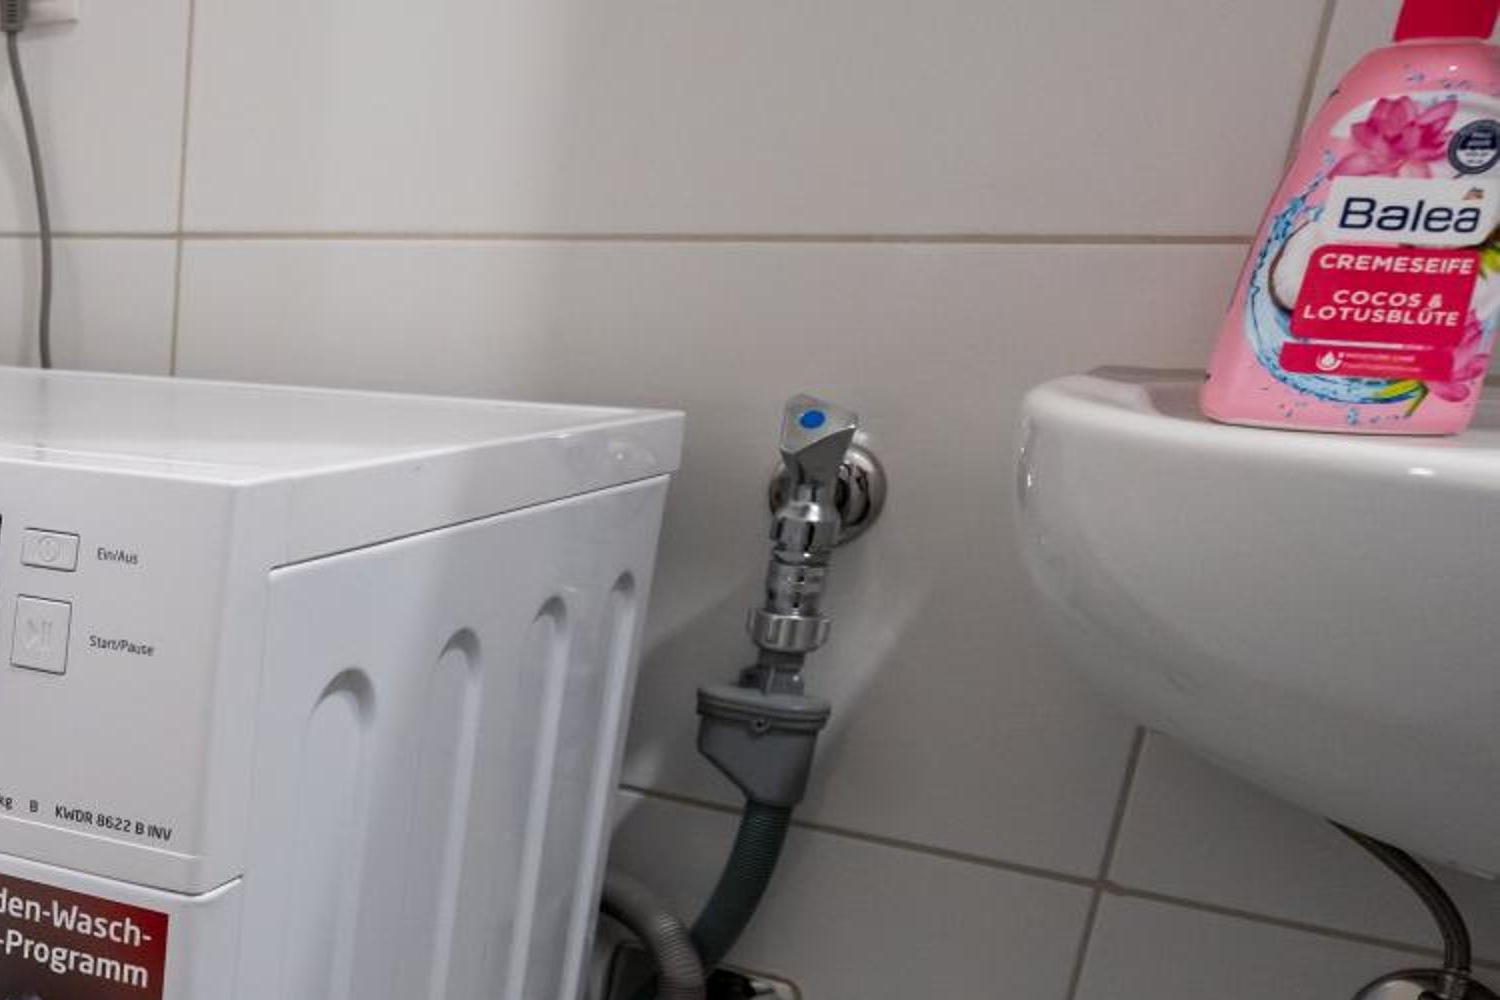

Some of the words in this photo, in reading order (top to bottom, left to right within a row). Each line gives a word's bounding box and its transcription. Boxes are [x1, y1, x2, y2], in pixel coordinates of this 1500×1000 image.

[1338, 196, 1482, 233] Balea
[1318, 252, 1476, 275] CREMESEIFE
[1332, 289, 1422, 309] COCOS
[1428, 293, 1443, 309] &
[1302, 304, 1461, 327] LOTUSBLÜTE
[97, 546, 139, 565] Ein/Aus
[89, 634, 156, 657] Start/Pause
[29, 799, 39, 813] B
[55, 805, 93, 825] KWDR
[96, 814, 132, 833] 8622
[135, 821, 145, 836] B
[147, 825, 173, 841] INV
